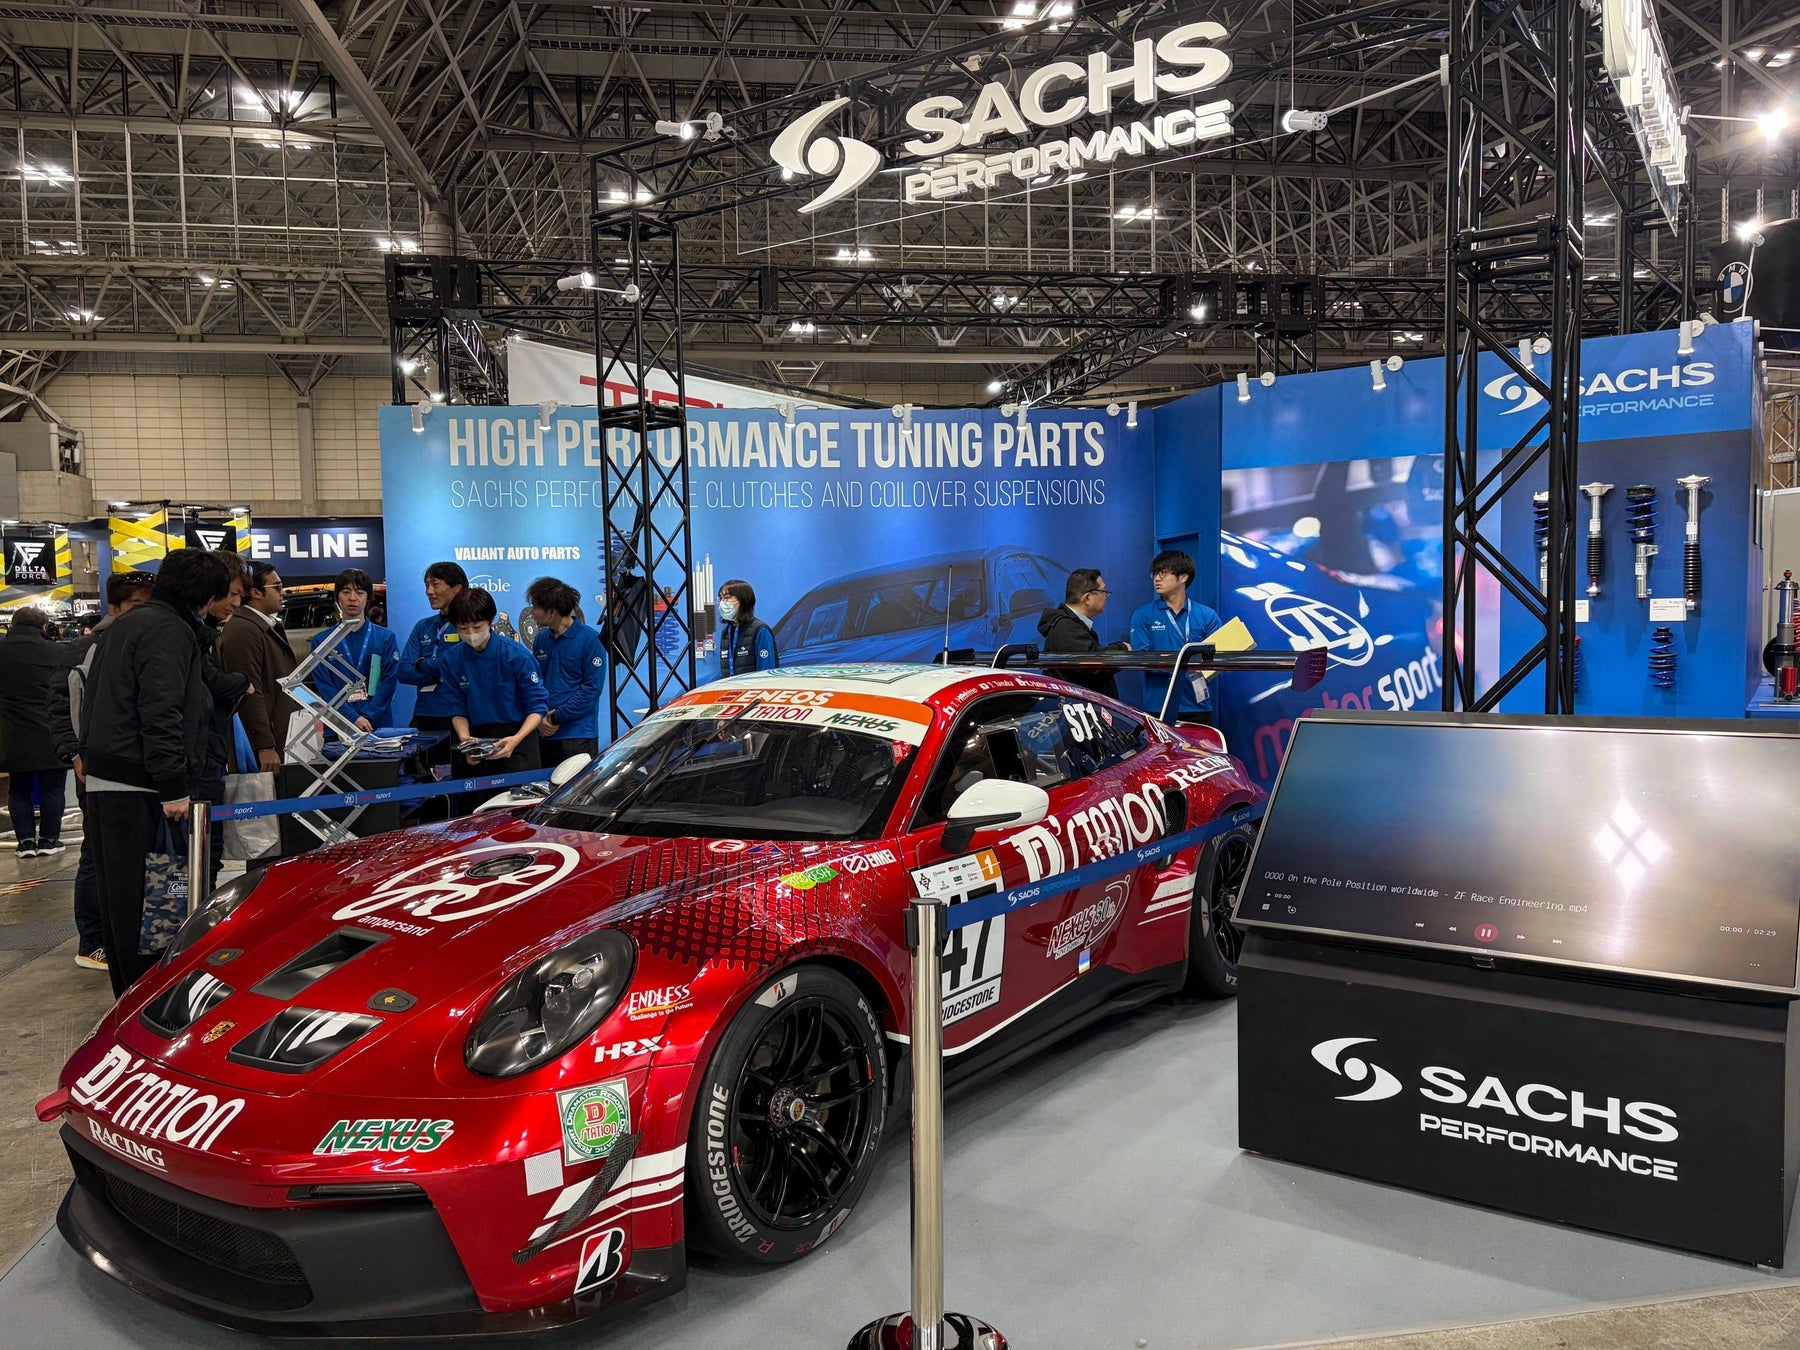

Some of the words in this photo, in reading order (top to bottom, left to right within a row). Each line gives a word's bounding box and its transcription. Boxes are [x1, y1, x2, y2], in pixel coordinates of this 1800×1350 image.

[904, 22, 1233, 156] SACHS
[906, 99, 1234, 205] PERFORMANCE
[1719, 264, 1747, 282] BMW
[1563, 394, 1714, 422] RFORMANCE
[448, 418, 544, 467] HIGH
[851, 422, 983, 468] TUNING
[993, 421, 1105, 467] PARTS
[451, 480, 528, 508] SACHS
[706, 481, 813, 509] CLUTCHES
[821, 481, 863, 508] AND
[870, 480, 966, 508] COILOVER
[974, 478, 1105, 507] SUSPENSIONS
[454, 547, 504, 561] VALIANT
[507, 547, 539, 560] AUTO
[541, 546, 581, 560] PARTS
[15, 572, 47, 580] FORCE
[468, 578, 511, 592] nable
[737, 690, 834, 706] ENEOS
[823, 712, 900, 732] NEXUS
[1063, 702, 1102, 743] ST1
[867, 849, 897, 867] ENKEI
[984, 854, 995, 876] 1
[1144, 846, 1160, 858] SACHS
[1018, 887, 1040, 901] SACHS
[1303, 876, 1317, 884] the
[1321, 877, 1342, 888] Pole
[1346, 880, 1387, 892] Position
[1391, 885, 1440, 898] worldwide
[1454, 891, 1466, 900] ZF
[1470, 893, 1494, 904] Race
[357, 915, 435, 938] ampersand
[942, 882, 998, 992] 47
[1046, 904, 1097, 958] NEXUS
[1720, 925, 1743, 933] 00:00
[1753, 928, 1777, 937] 02:29
[629, 983, 690, 1017] ENDLESS
[630, 1012, 657, 1021] Challenge
[674, 1002, 694, 1012] Future
[941, 985, 996, 1022] IDGESTONE
[594, 1034, 665, 1063] HRX
[566, 1089, 598, 1126] DRAMATIC
[600, 1089, 625, 1115] RESORT
[1419, 1066, 1679, 1143] SACHS
[87, 1116, 165, 1167] RACING
[312, 1118, 455, 1155] NEXUS
[567, 1128, 593, 1154] RESORT
[579, 1122, 617, 1142] STATION
[1419, 1113, 1679, 1181] PERFORMANCE
[706, 1082, 759, 1244] BRIDGESTONE
